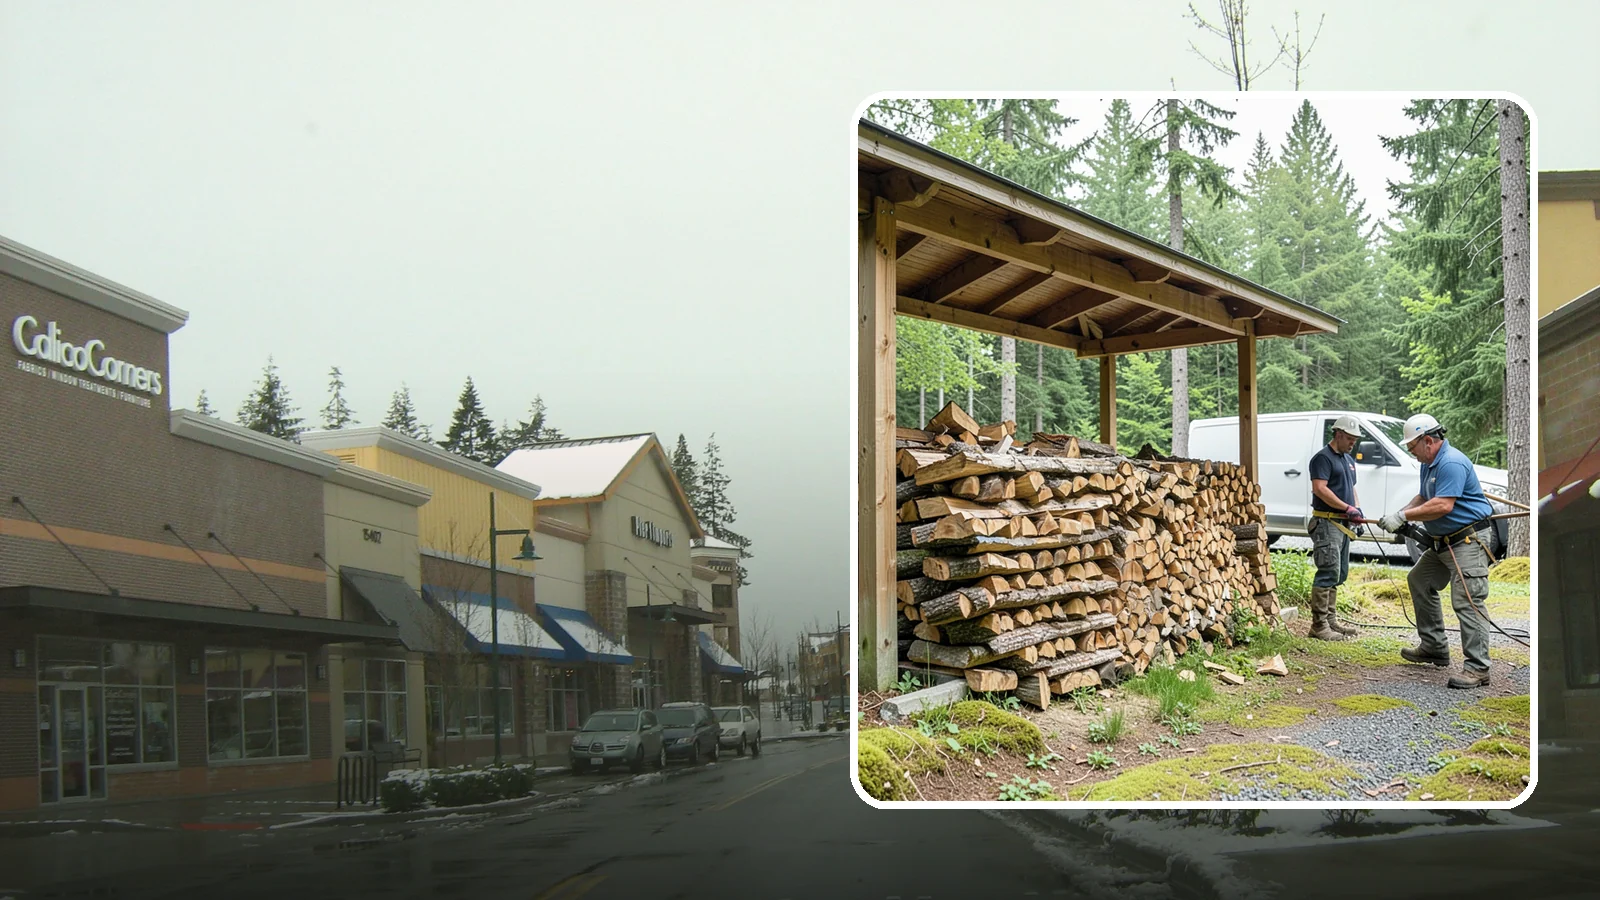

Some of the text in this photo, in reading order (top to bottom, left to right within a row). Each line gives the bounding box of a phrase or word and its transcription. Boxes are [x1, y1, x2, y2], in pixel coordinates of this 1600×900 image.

[17, 360, 151, 408] FABRICS WINDOW TREATMENTS FURNITURE
